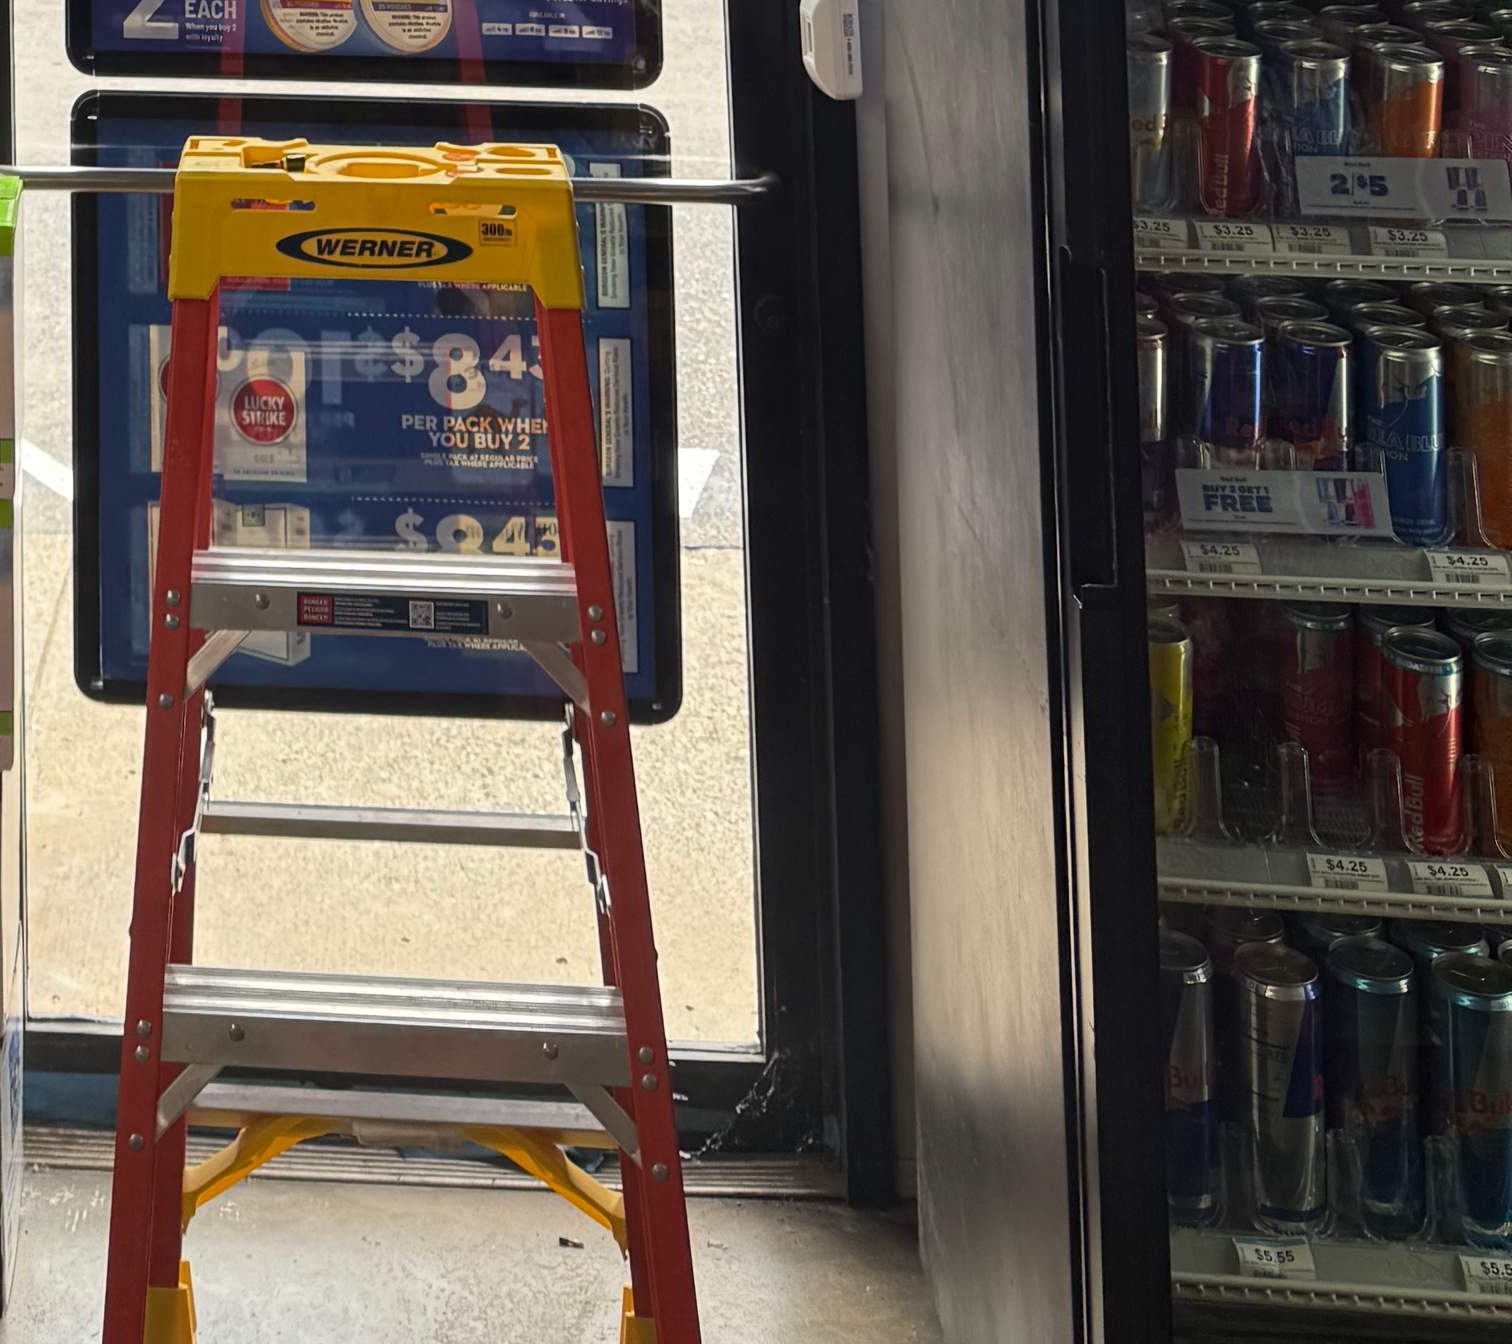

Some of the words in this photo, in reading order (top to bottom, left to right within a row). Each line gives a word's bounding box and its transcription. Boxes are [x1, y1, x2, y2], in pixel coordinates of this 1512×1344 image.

[185, 0, 237, 20] EACH
[204, 23, 217, 33] you
[218, 23, 231, 34] buy
[1214, 224, 1254, 236] $3.25
[1290, 225, 1331, 238] $3.25
[1388, 230, 1429, 243] $3.25
[315, 238, 435, 259] WERNER
[481, 283, 527, 292] APPLICABLE
[244, 395, 286, 412] LUCKY
[241, 410, 287, 427] STRIKE
[402, 414, 437, 431] PER
[443, 416, 491, 433] PACK
[429, 432, 470, 448] YOU
[474, 433, 514, 450] BUY
[518, 434, 530, 451] 2
[486, 462, 535, 470] APPLICABLE
[1203, 493, 1274, 513] FREE
[1200, 543, 1241, 556] $4.25
[1446, 554, 1489, 567] $4.25
[1326, 859, 1368, 873] $4.25
[1427, 865, 1469, 878] $4.25
